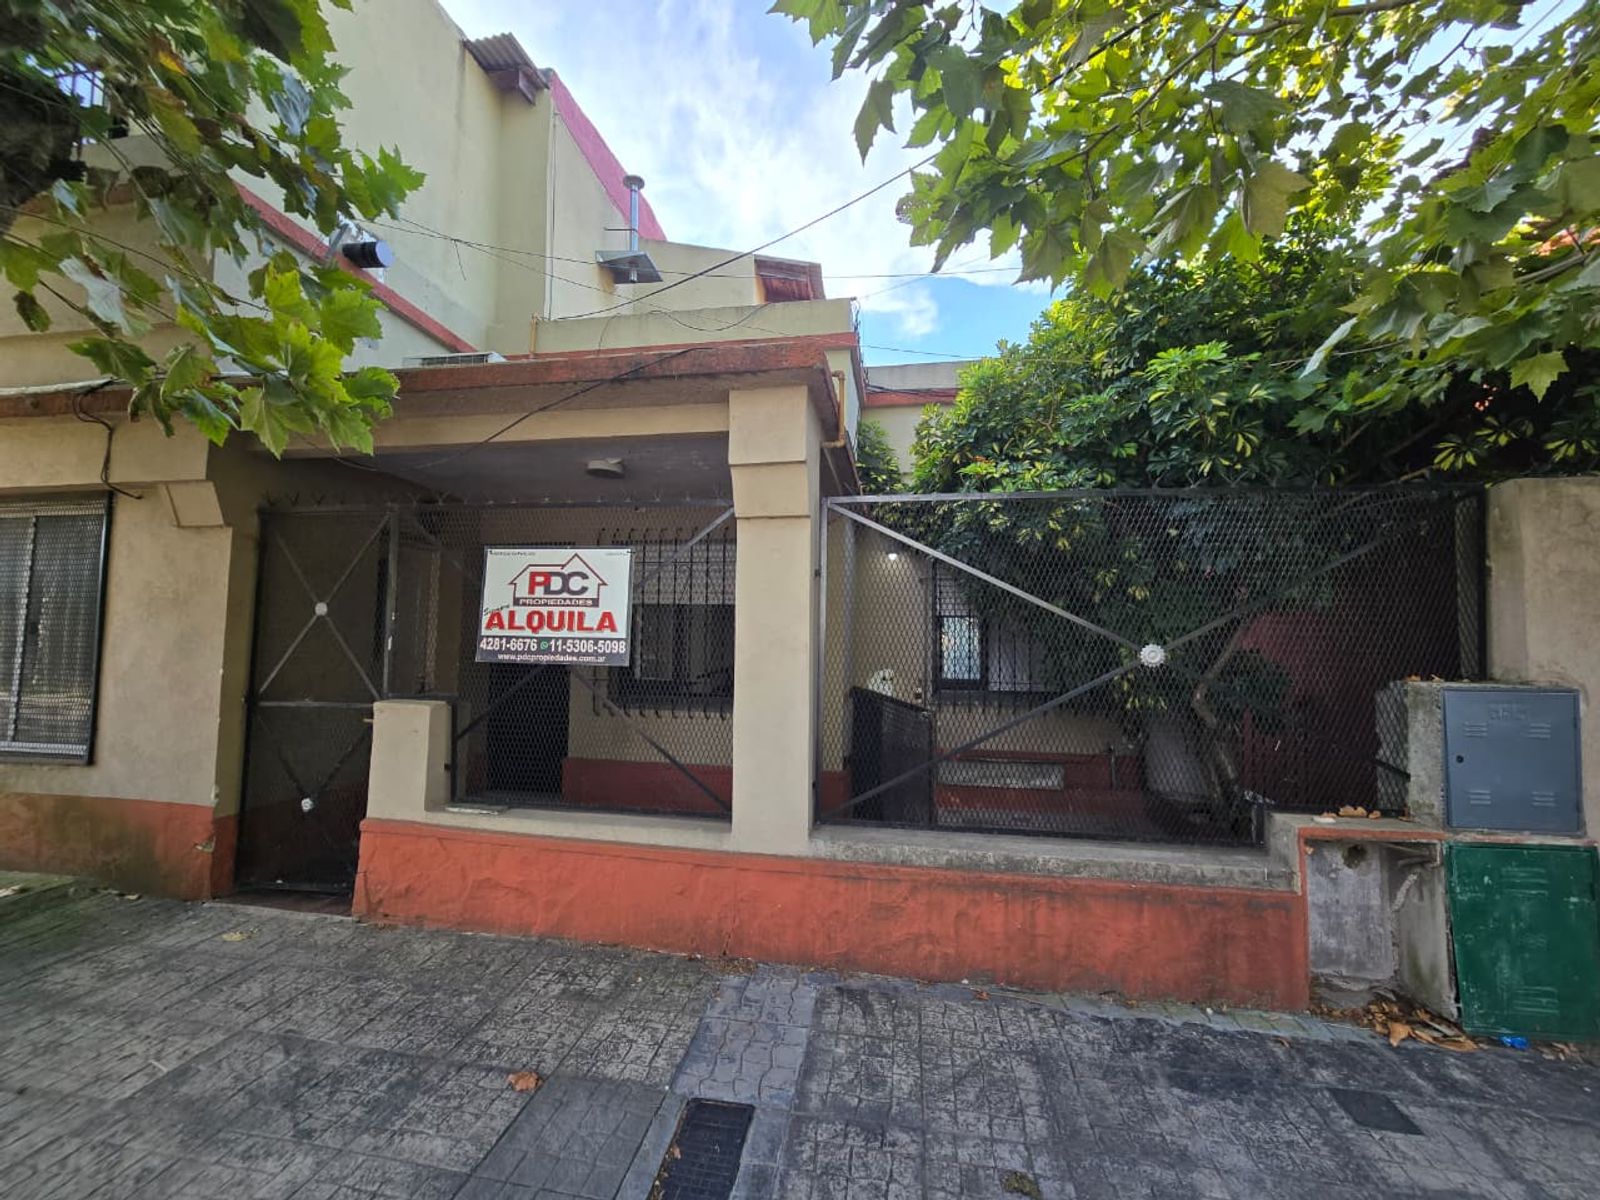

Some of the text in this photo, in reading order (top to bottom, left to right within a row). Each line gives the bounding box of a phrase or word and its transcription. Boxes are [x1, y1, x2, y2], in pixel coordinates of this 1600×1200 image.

[528, 571, 589, 596] PDC
[519, 598, 593, 606] PROPIEDADES
[485, 610, 618, 634] ALQUILA
[480, 638, 626, 654] 4281-6676 11-5306-5098
[497, 654, 606, 663] www.pdcpropiedades.com.ar
